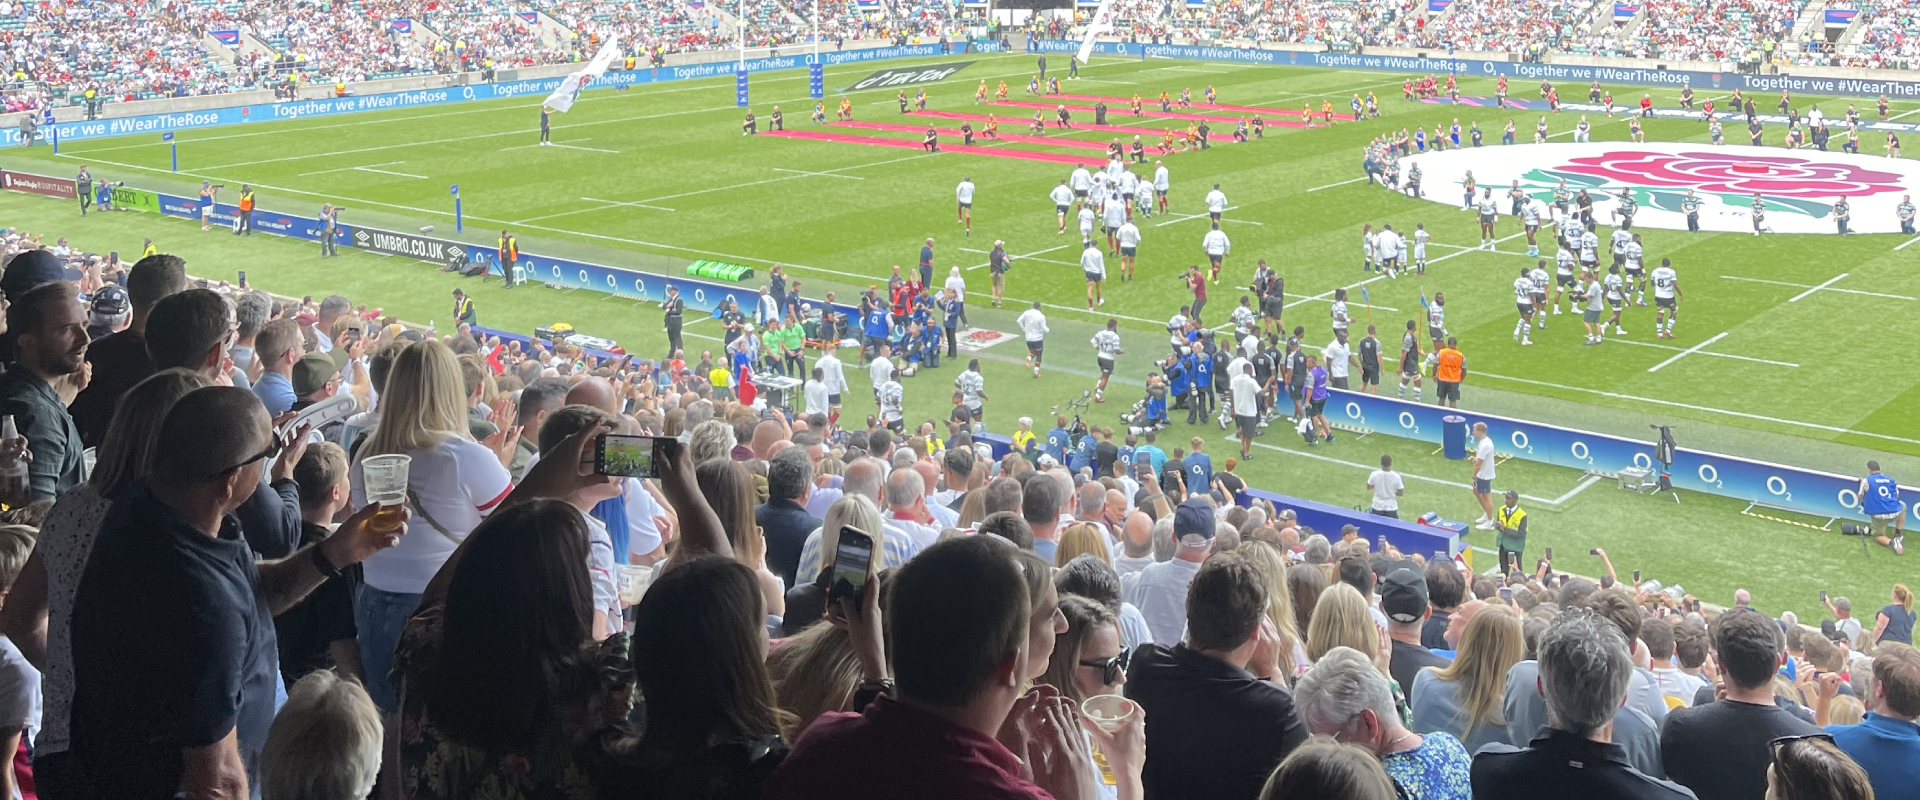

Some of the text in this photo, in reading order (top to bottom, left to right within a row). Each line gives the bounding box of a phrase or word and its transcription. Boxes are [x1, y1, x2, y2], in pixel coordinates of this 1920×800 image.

[826, 46, 933, 64] Together we #WearTheRose
[1184, 48, 1199, 57] we
[1201, 47, 1274, 62] #WearTheRose
[1314, 53, 1467, 72] Together we #WearTheRose
[673, 57, 795, 80] Together we #WearTheRose
[1514, 63, 1690, 84] Together we #WearTheRose
[492, 79, 546, 97] Together
[547, 81, 559, 90] we
[1743, 75, 1808, 91] Together
[1811, 80, 1834, 91] we
[273, 90, 447, 118] Together we #WearTheRose
[81, 125, 105, 136] we
[110, 112, 218, 133] #WearTheRose
[373, 232, 444, 260] UMBRO.CO.UK
[1345, 402, 1365, 425] O2
[1399, 411, 1419, 434] O2
[1511, 430, 1533, 454] O2
[1571, 441, 1594, 465] O2
[1699, 464, 1723, 489] O2
[1766, 475, 1792, 501] O2
